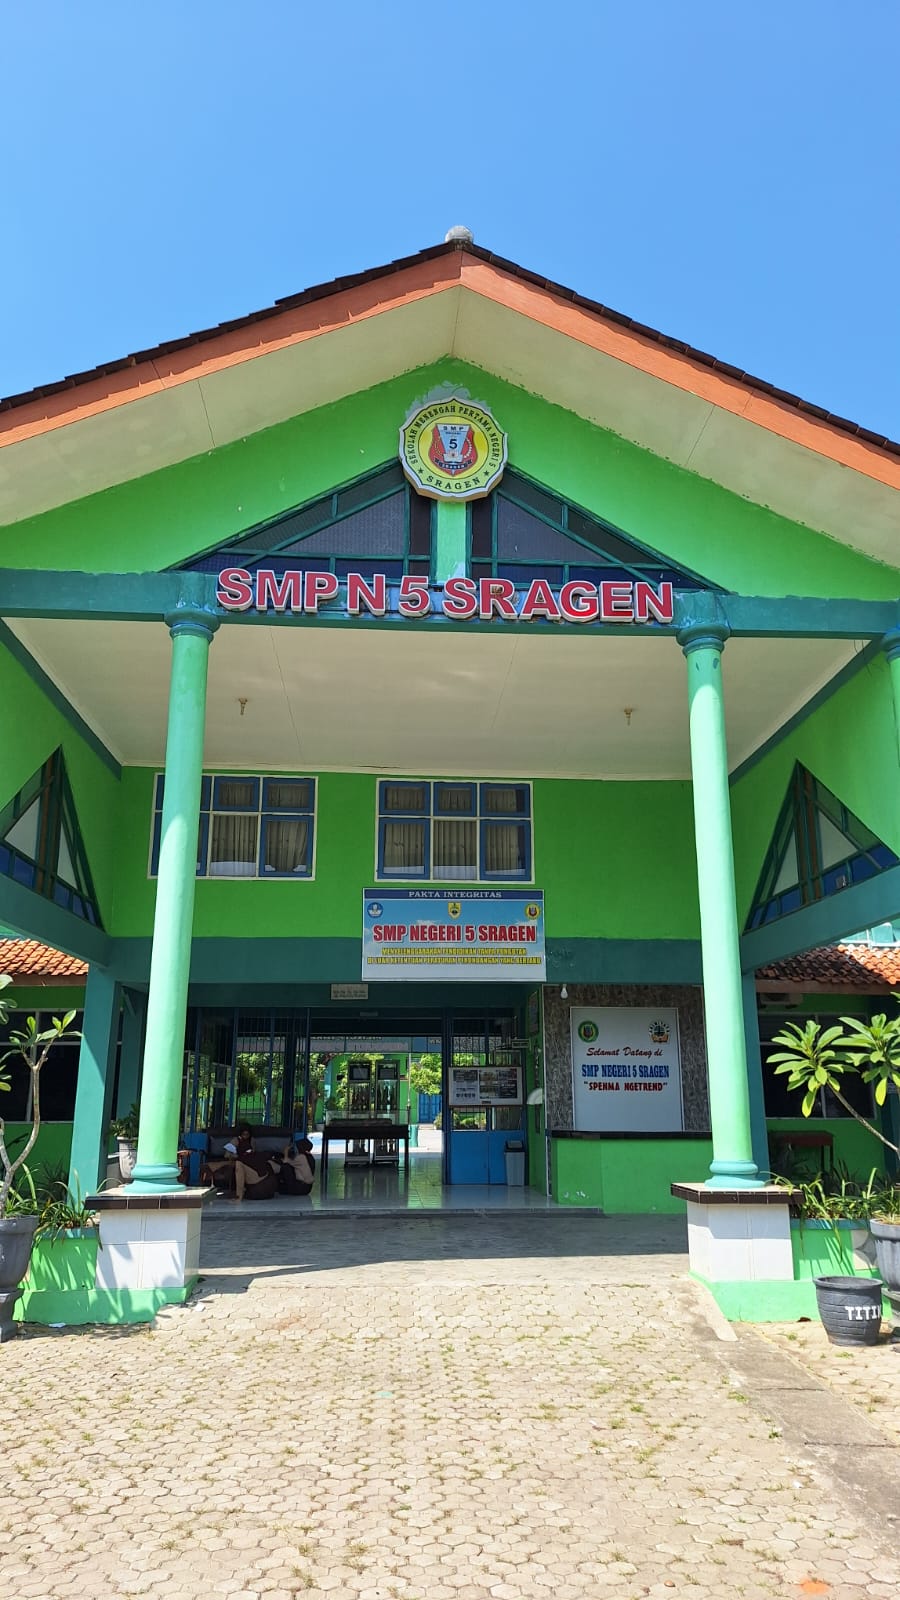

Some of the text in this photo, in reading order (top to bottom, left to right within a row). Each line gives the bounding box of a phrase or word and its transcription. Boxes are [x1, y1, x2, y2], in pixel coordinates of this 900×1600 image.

[407, 428, 418, 465] SEKOLAH
[415, 405, 456, 428] MENENGAH
[458, 406, 492, 432] PERTAMA
[489, 432, 500, 461] NEGERI
[449, 438, 458, 450] 5
[426, 475, 480, 490] SRAGEN
[216, 567, 674, 623] SMP N 5 SRAGEN
[373, 924, 536, 942] SMP NEGERI 5 SRAGEN
[586, 1046, 663, 1059] Selamat Datang di
[581, 1064, 670, 1078] SMP NEGERI 5 SRAGEN
